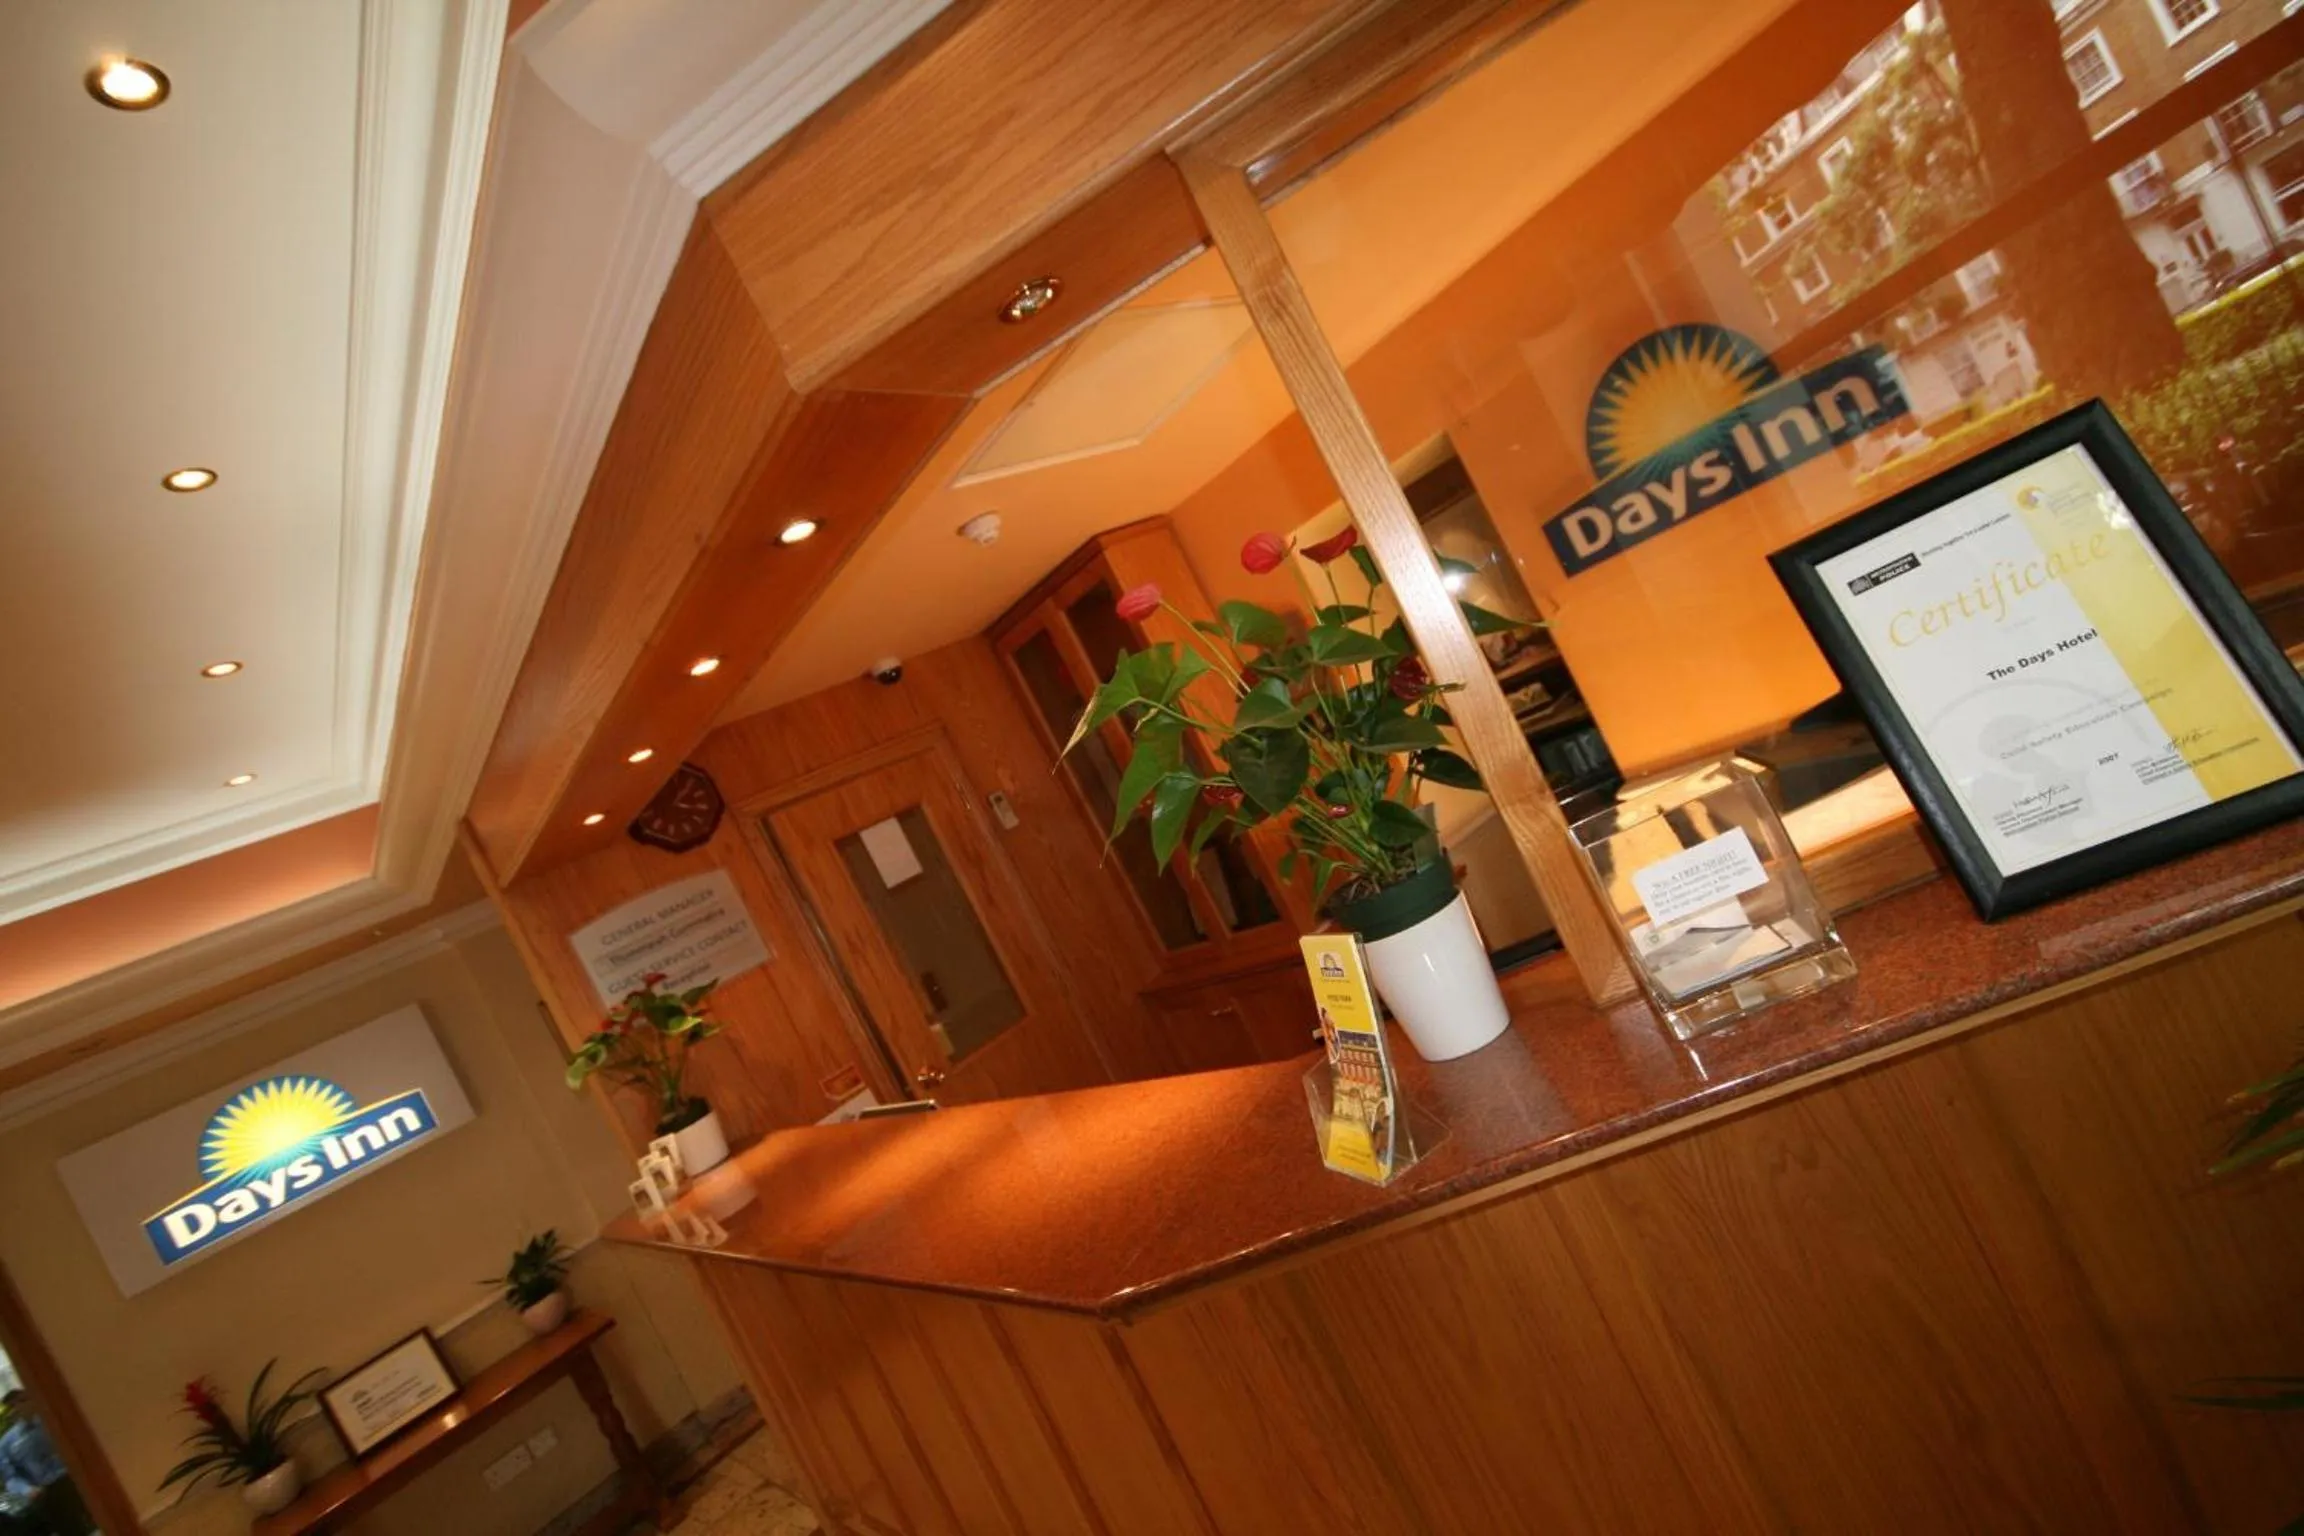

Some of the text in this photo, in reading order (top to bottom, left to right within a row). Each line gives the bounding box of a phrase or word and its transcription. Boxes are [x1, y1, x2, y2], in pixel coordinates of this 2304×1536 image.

[1561, 374, 1883, 560] Days Inn
[1888, 532, 2112, 648] Certificate
[1986, 628, 2098, 681] The Days Hotel
[601, 915, 656, 946] GENERAL
[657, 888, 715, 919] MANAGER
[162, 1105, 423, 1250] Days Inn
